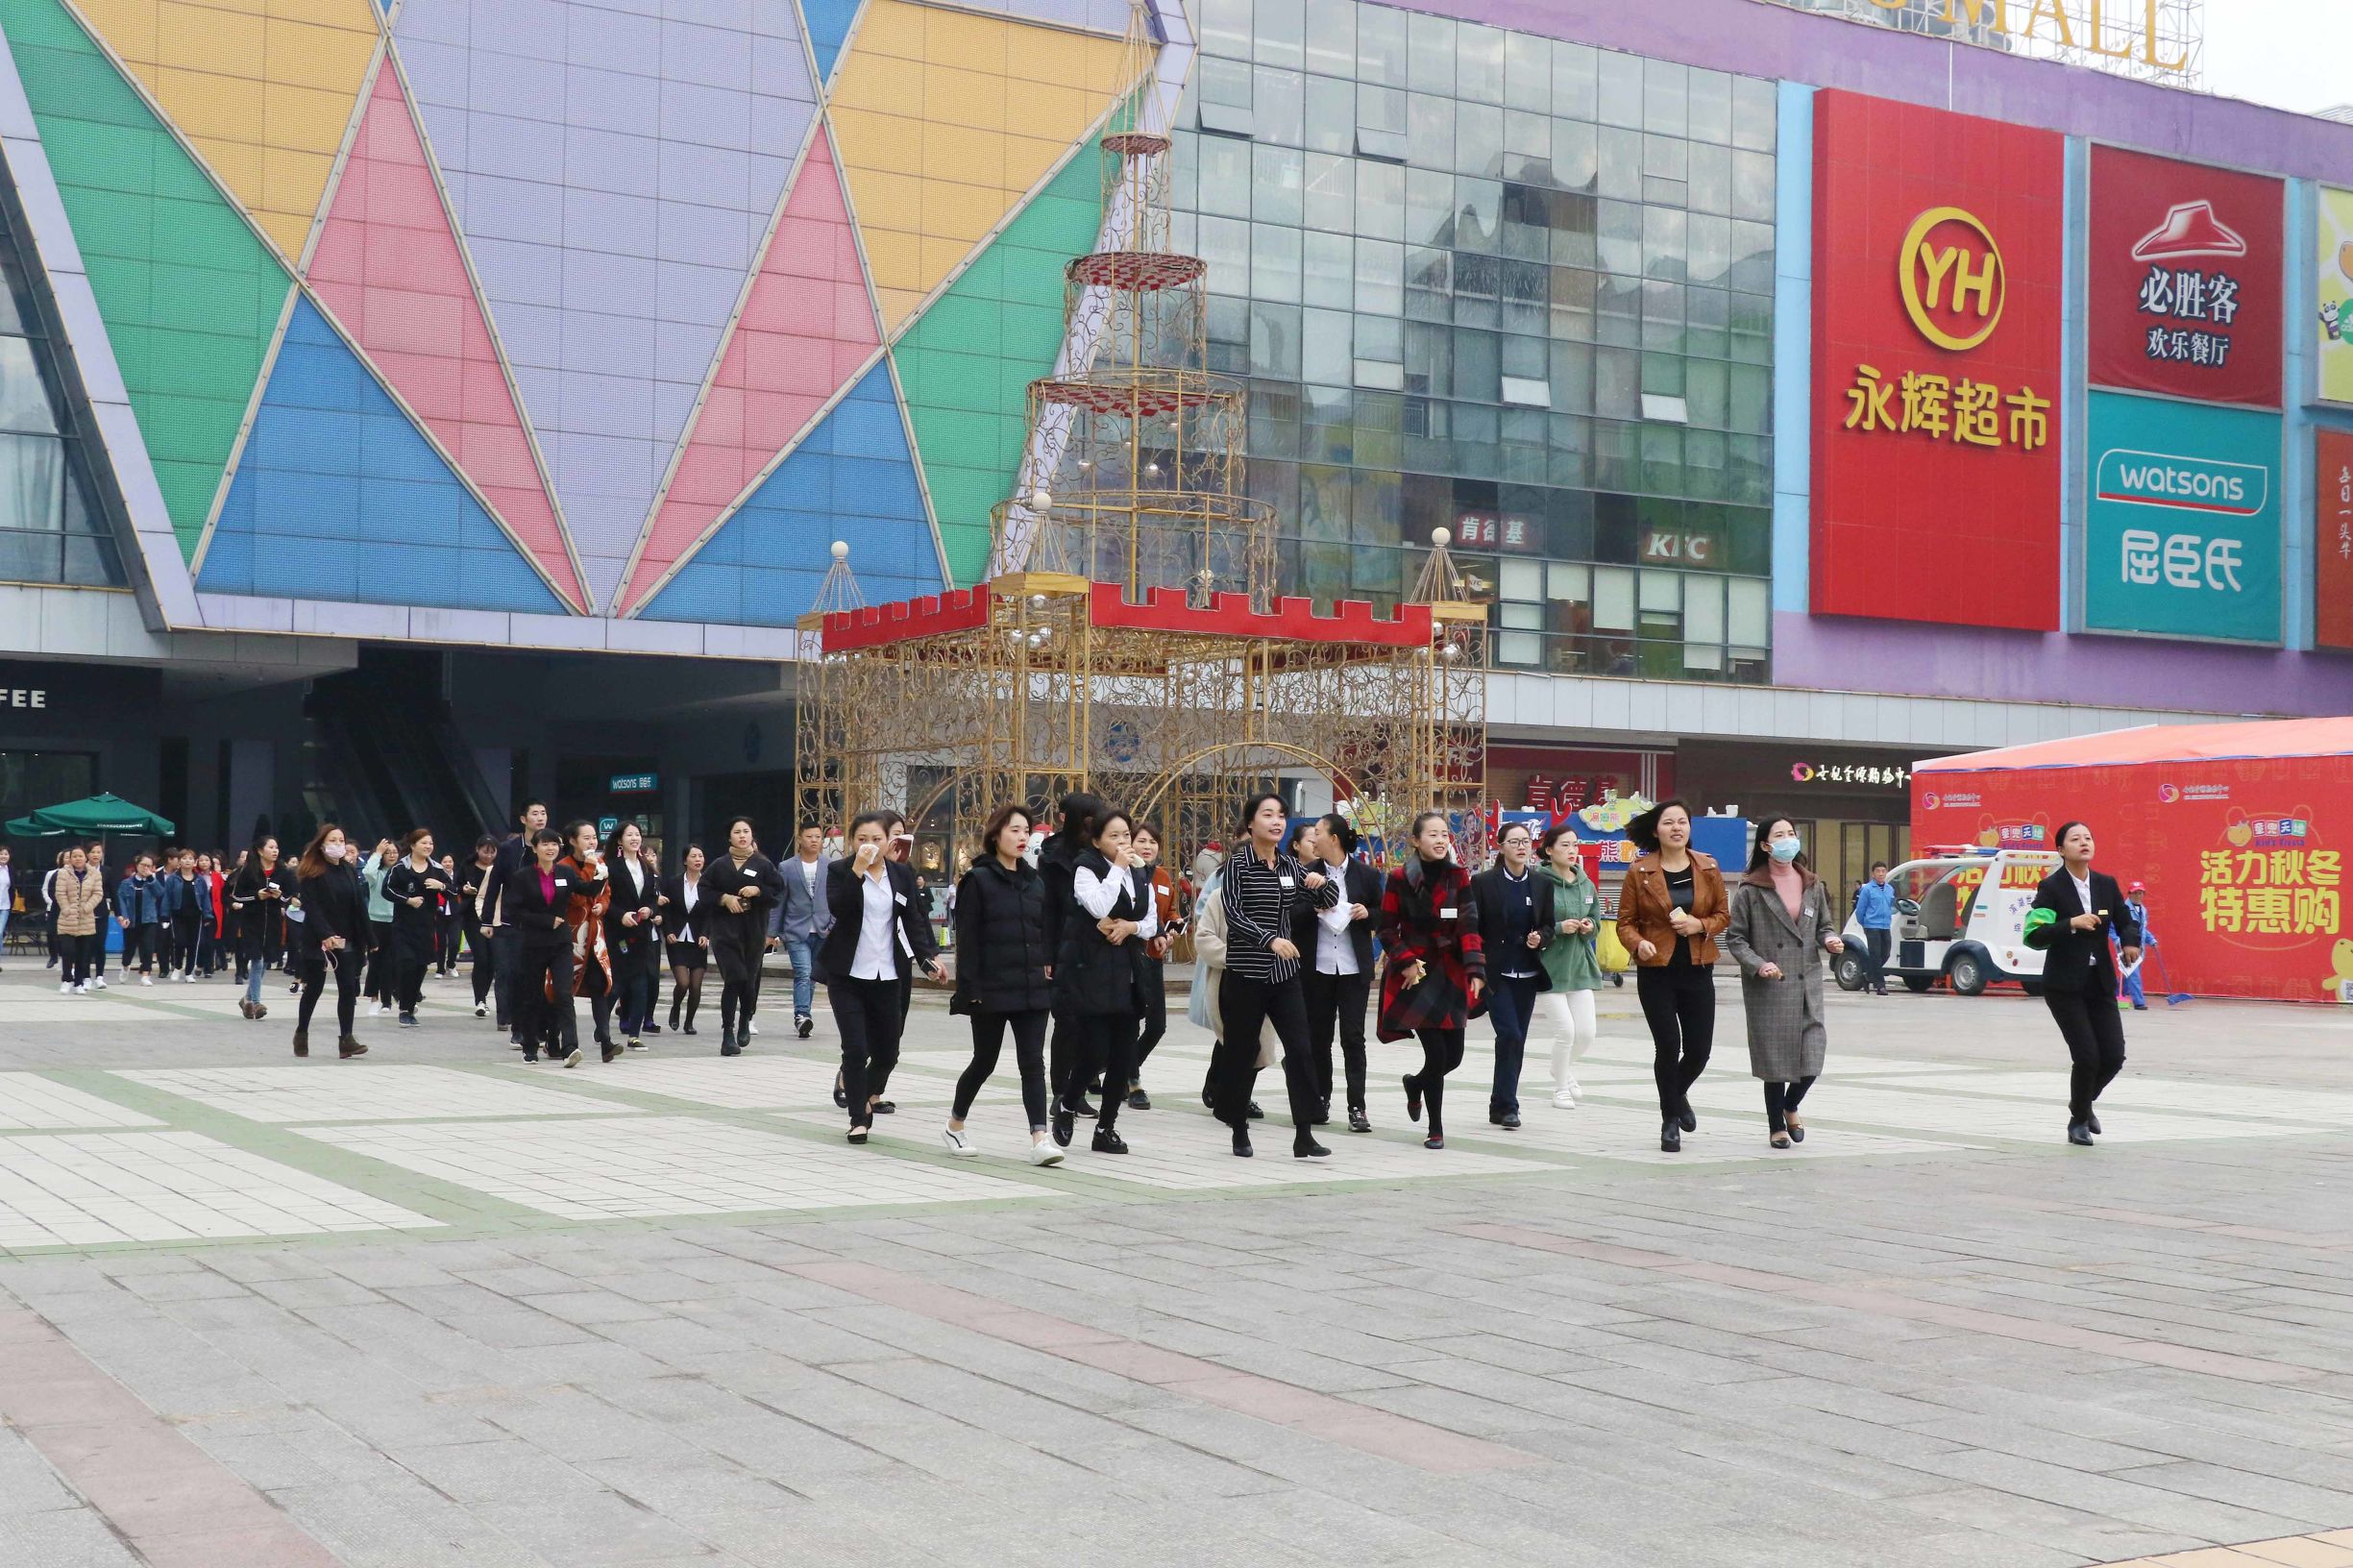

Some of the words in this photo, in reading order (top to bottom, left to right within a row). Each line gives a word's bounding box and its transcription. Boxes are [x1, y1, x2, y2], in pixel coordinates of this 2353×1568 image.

[1920, 241, 1996, 316] YH
[2140, 266, 2239, 324] 必胜客
[2147, 328, 2229, 365] 欢乐餐厅
[1845, 363, 2051, 451] 永辉超市
[2120, 463, 2244, 501] watsons
[1647, 532, 1709, 560] KFC
[2121, 528, 2243, 592] 屈臣氏
[2200, 849, 2342, 885] 活力秋冬
[2200, 886, 2341, 934] 特惠购
